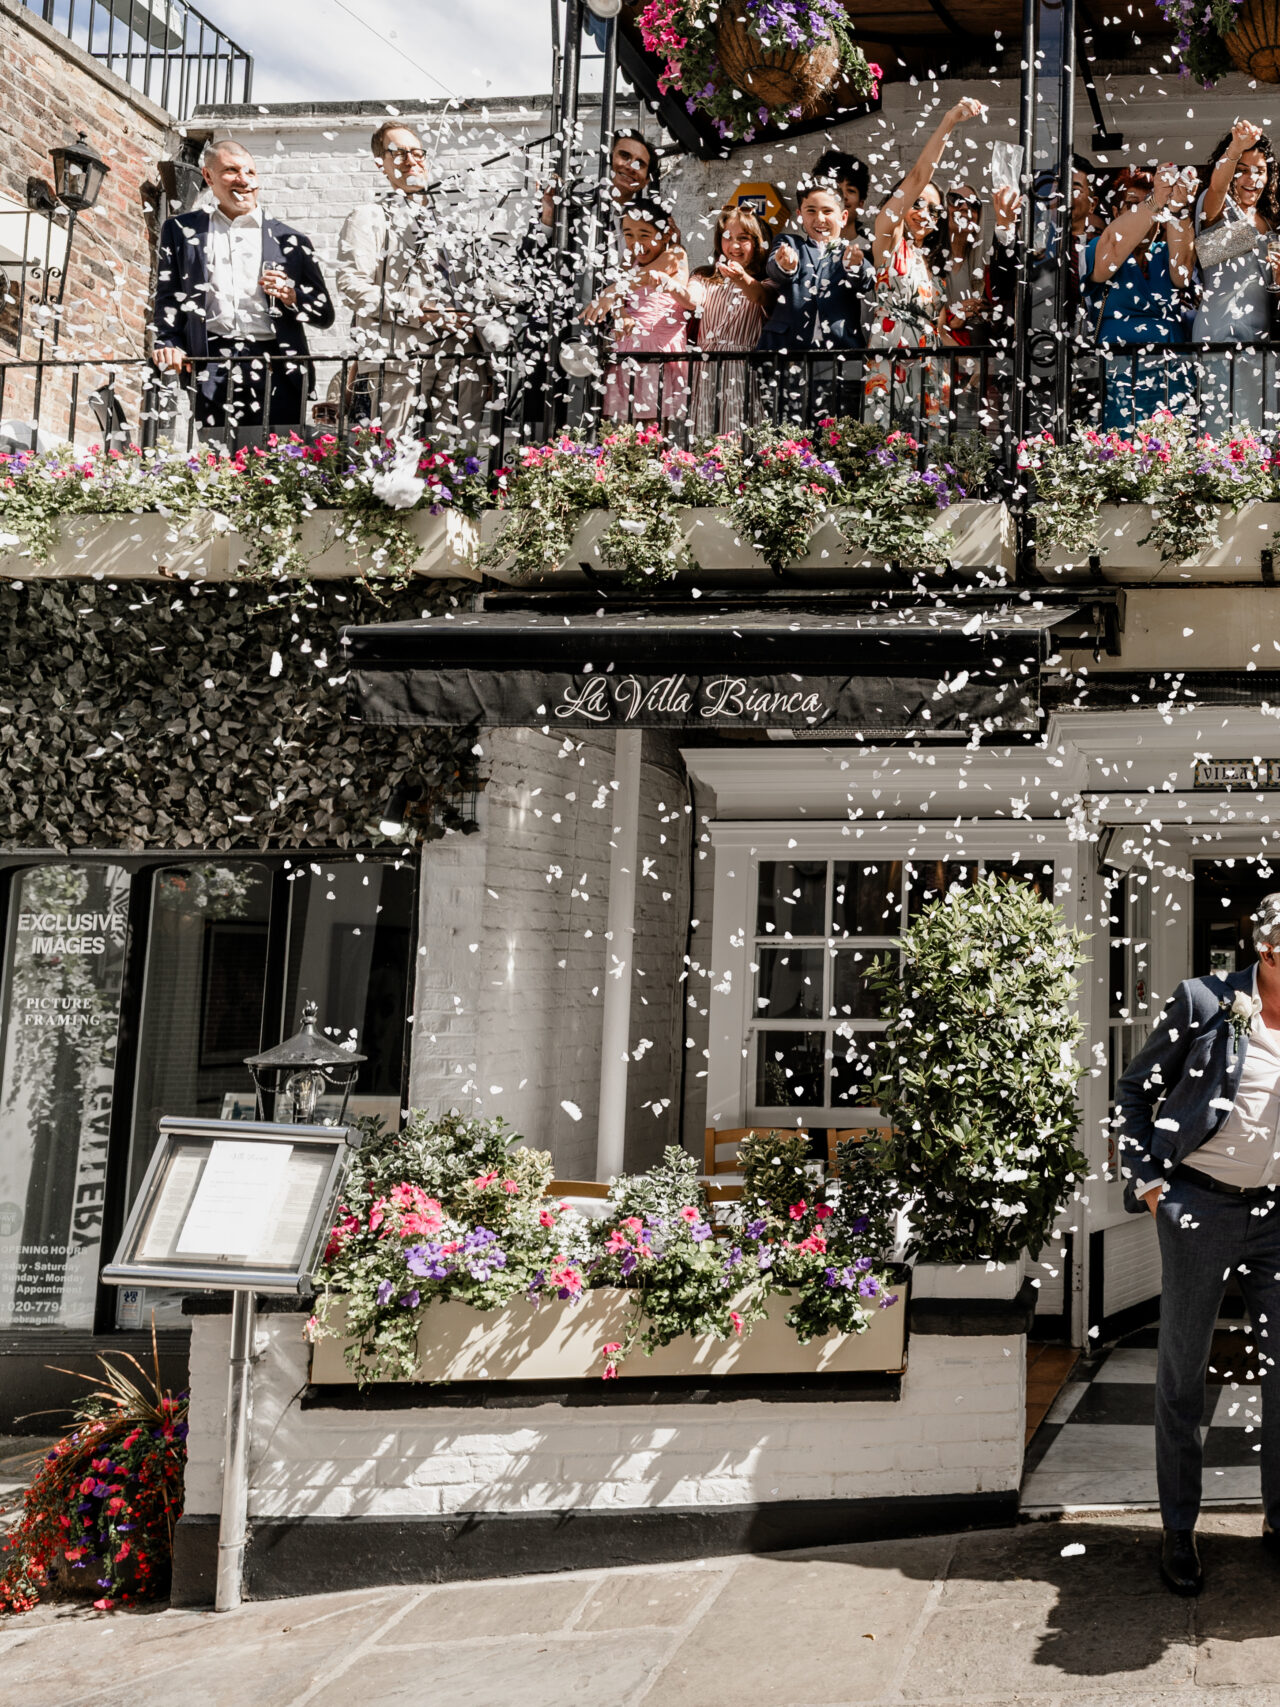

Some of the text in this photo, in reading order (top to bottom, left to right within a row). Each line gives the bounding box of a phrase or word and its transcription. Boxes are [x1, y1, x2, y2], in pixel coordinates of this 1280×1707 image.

[554, 673, 822, 722] La Villa Bianca
[17, 913, 124, 931] EXCLUSIVE
[31, 936, 106, 954] IMAGES
[25, 997, 92, 1010] PICTURE
[24, 1014, 100, 1026] FRAMING
[2, 1246, 88, 1256] OPENING HOURS
[34, 1261, 80, 1273] Saturday
[2, 1273, 39, 1284] Sunday
[45, 1273, 84, 1284] Monday
[16, 1285, 82, 1295] Appointment
